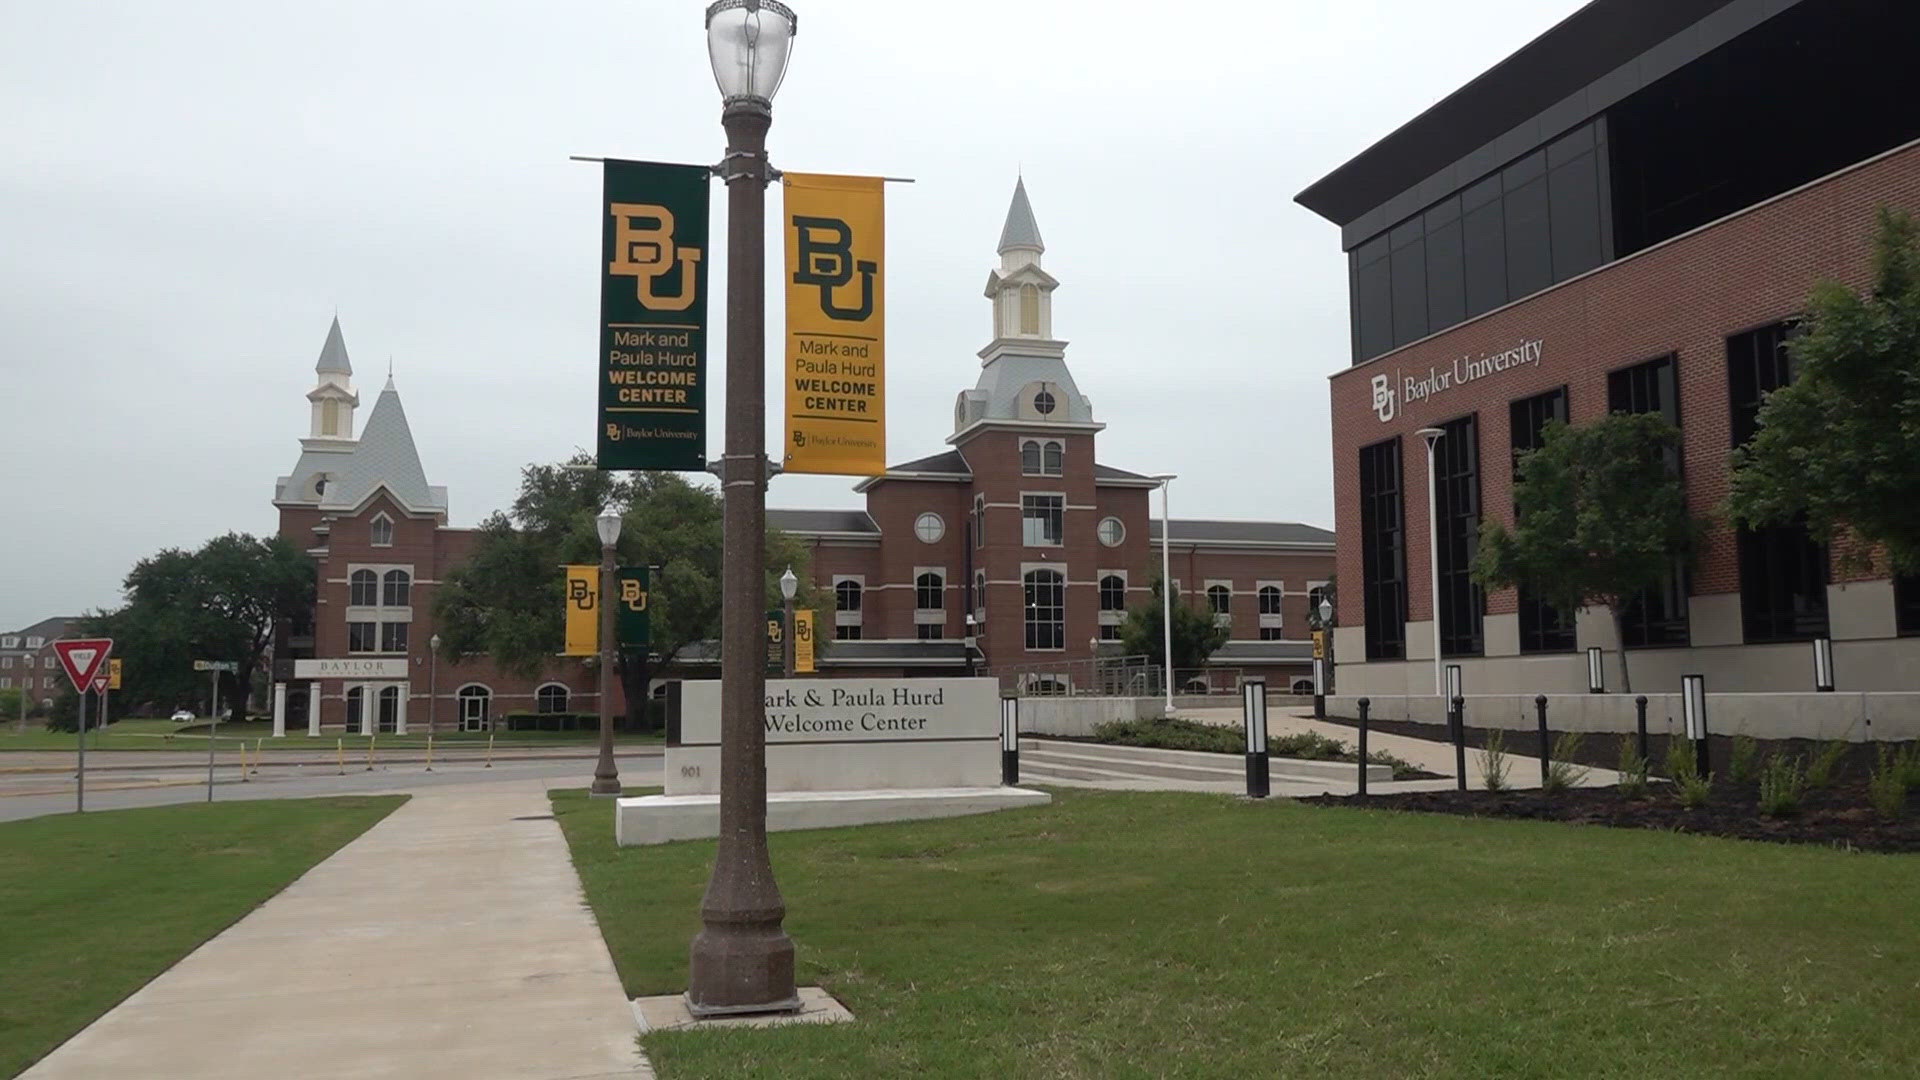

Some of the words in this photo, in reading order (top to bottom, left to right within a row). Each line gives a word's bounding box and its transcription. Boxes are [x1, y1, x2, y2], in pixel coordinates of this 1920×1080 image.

[609, 202, 701, 311] BU
[792, 215, 877, 321] BU
[614, 331, 655, 346] Mark
[658, 332, 688, 347] and
[800, 340, 838, 355] Mark
[841, 344, 868, 358] and
[610, 351, 653, 365] Paula
[658, 352, 696, 366] Hurd
[795, 359, 837, 374] Paula
[841, 362, 875, 377] Hurd
[609, 371, 697, 386] WELCOME
[795, 378, 876, 396] WELCOME
[1370, 373, 1395, 423] BU
[1404, 366, 1452, 403] Baylor
[1453, 338, 1544, 385] University
[619, 388, 686, 403] CENTER
[805, 396, 867, 412] CENTER
[627, 428, 654, 438] Baylor
[654, 429, 698, 440] University
[569, 579, 595, 610] BU
[621, 579, 648, 611] BU
[768, 620, 782, 642] BU
[796, 619, 811, 642] BU
[320, 661, 384, 670] BAYLOR
[765, 688, 796, 707] ark
[803, 688, 823, 706] &
[832, 688, 885, 706] Paula
[892, 687, 944, 706] Hurd
[764, 713, 855, 733] Welcome
[860, 712, 927, 731] Center
[681, 766, 701, 778] 901
